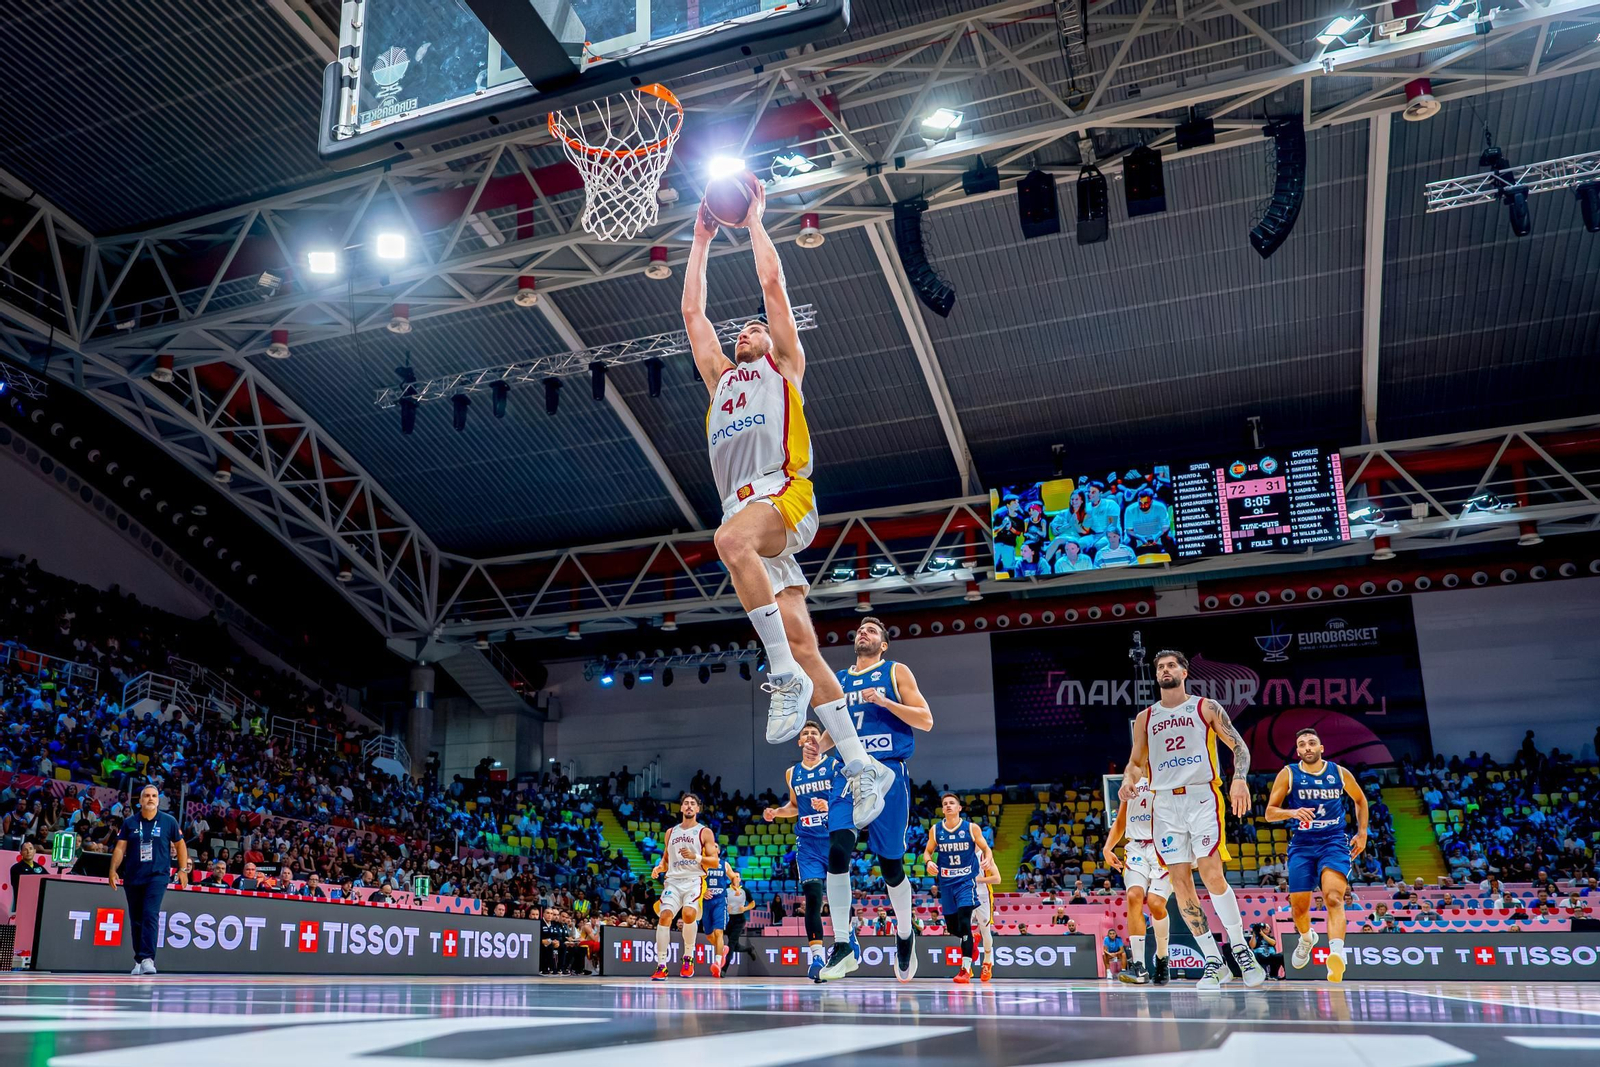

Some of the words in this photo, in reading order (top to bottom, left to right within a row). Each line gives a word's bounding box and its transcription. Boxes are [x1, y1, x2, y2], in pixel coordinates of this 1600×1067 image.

[721, 392, 747, 414] 44
[712, 414, 766, 445] endesa
[1292, 448, 1318, 458] CYPRUS
[1230, 485, 1245, 495] 72
[1266, 481, 1280, 490] 31
[1244, 496, 1270, 507] 8:05
[1241, 521, 1279, 530] TIME-OUTS
[1237, 542, 1242, 550] 1
[1298, 627, 1378, 645] EUROBASKET
[1056, 680, 1155, 705] MAKE
[1186, 678, 1256, 705] OUR
[1262, 678, 1375, 705] MARK
[854, 711, 864, 730] 7
[1152, 716, 1195, 735] ESPAÑA
[865, 737, 890, 749] KO
[1165, 736, 1186, 752] 22
[1158, 754, 1202, 771] endesa
[794, 780, 831, 796] CYPRUS
[1298, 789, 1339, 799] CYPRUS
[1140, 798, 1146, 808] 4
[1317, 804, 1326, 816] 4
[1130, 814, 1150, 822] ende
[672, 836, 694, 845] ESPAÑA
[939, 842, 969, 851] CYPRUS
[949, 855, 961, 865] 13
[157, 912, 266, 951] ISSOT
[322, 922, 420, 956] TISSOT
[460, 930, 532, 959] TISSOT
[1169, 956, 1203, 967] anten
[1343, 947, 1443, 965] TISSOT
[1498, 946, 1600, 965] TISSO
